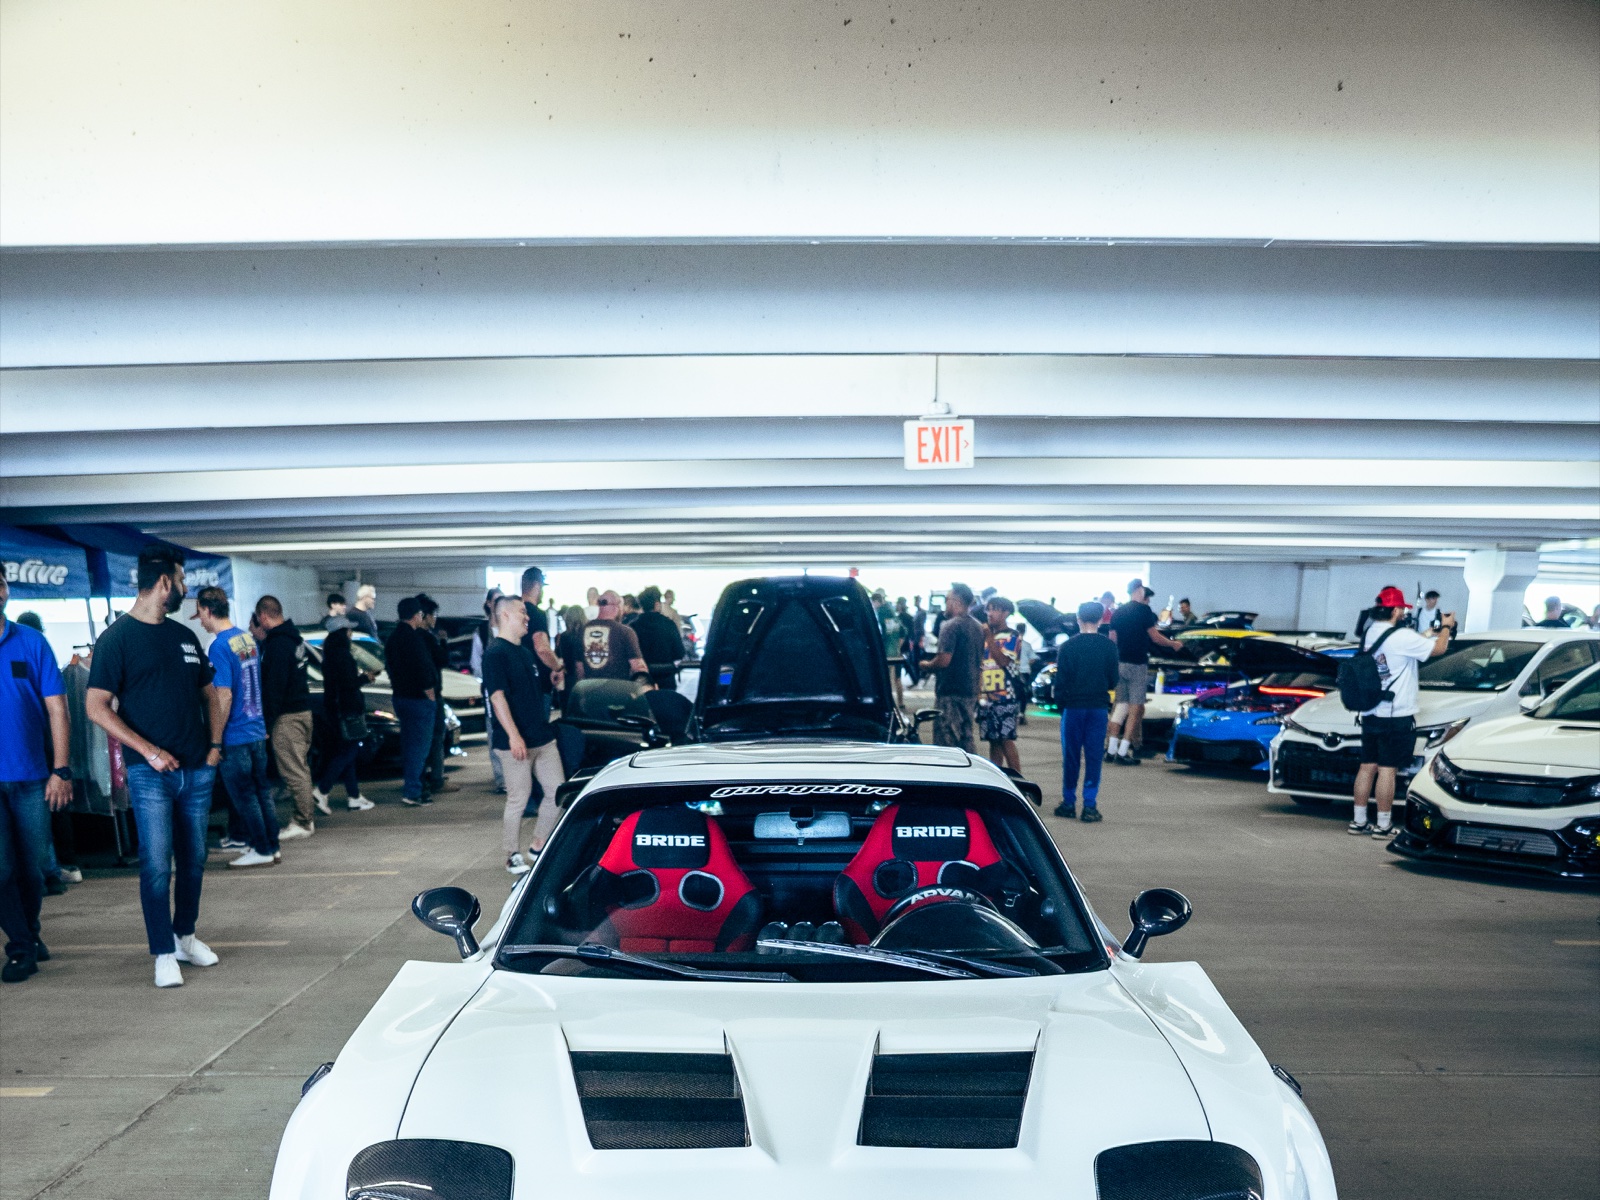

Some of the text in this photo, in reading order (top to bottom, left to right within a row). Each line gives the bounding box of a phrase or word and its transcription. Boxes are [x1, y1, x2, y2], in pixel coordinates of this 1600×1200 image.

[917, 426, 964, 463] EXIT
[2, 559, 68, 585] efive
[711, 784, 902, 798] garagefive
[896, 826, 967, 838] BRIDE
[635, 834, 706, 847] BRIDE
